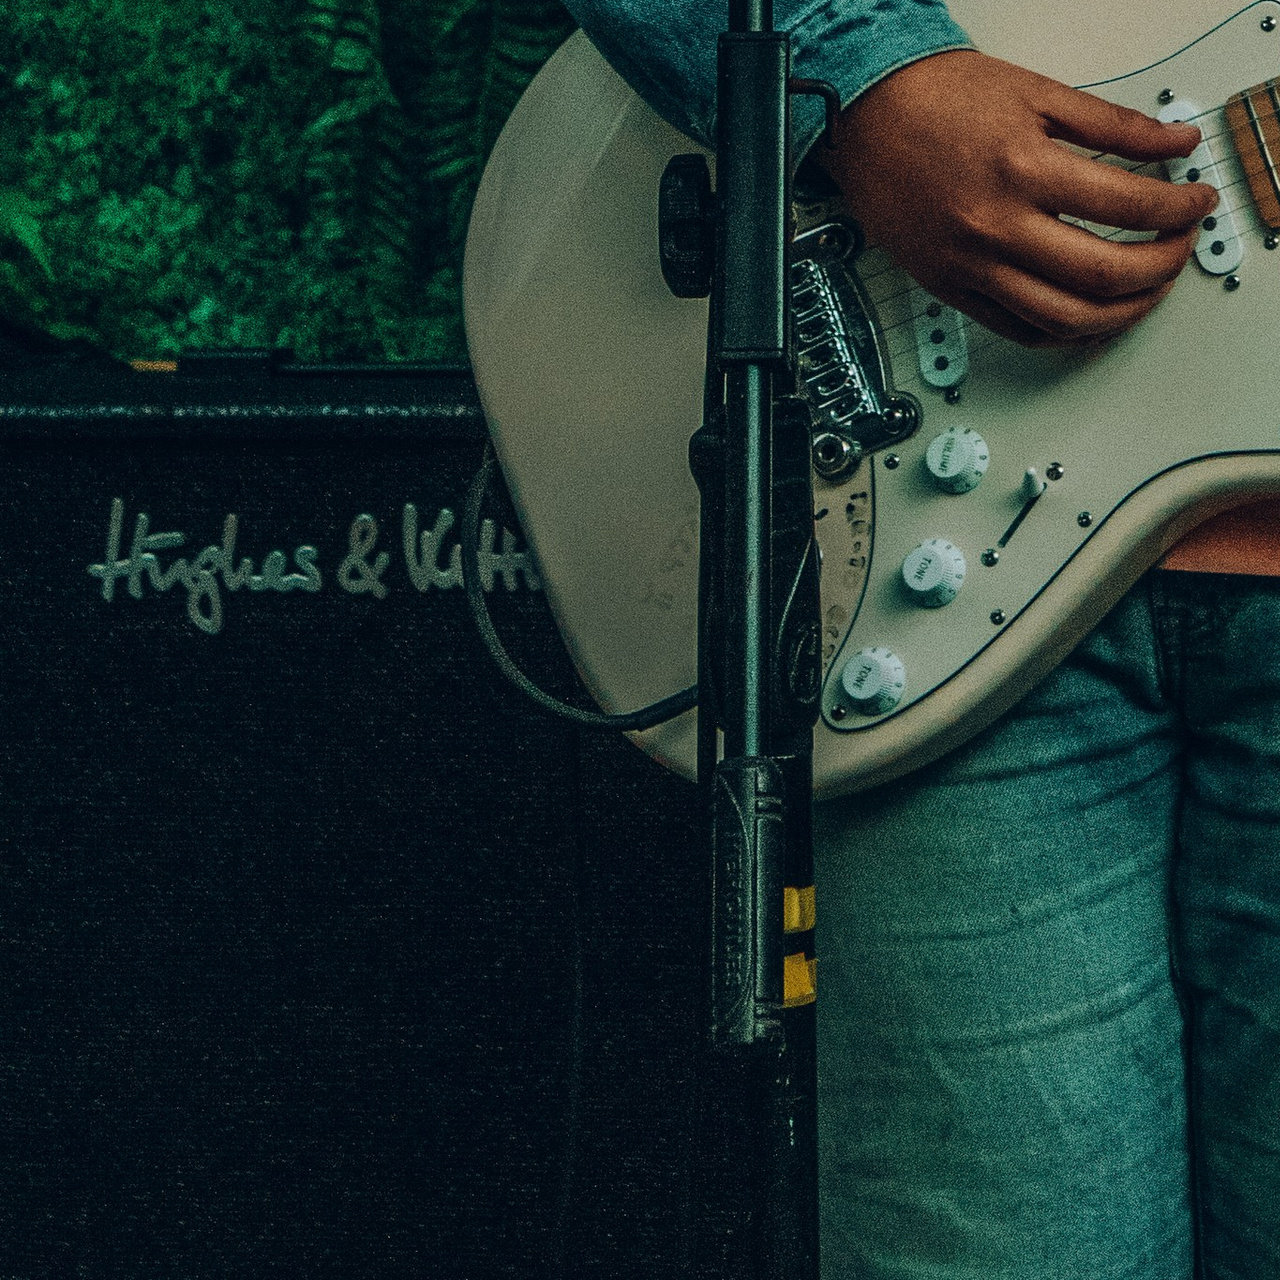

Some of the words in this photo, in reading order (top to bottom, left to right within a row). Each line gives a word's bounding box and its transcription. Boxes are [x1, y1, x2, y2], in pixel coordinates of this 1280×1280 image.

[88, 497, 323, 635] Hughes
[337, 513, 391, 599] &
[913, 557, 932, 581] TONE
[852, 665, 872, 690] TONE
